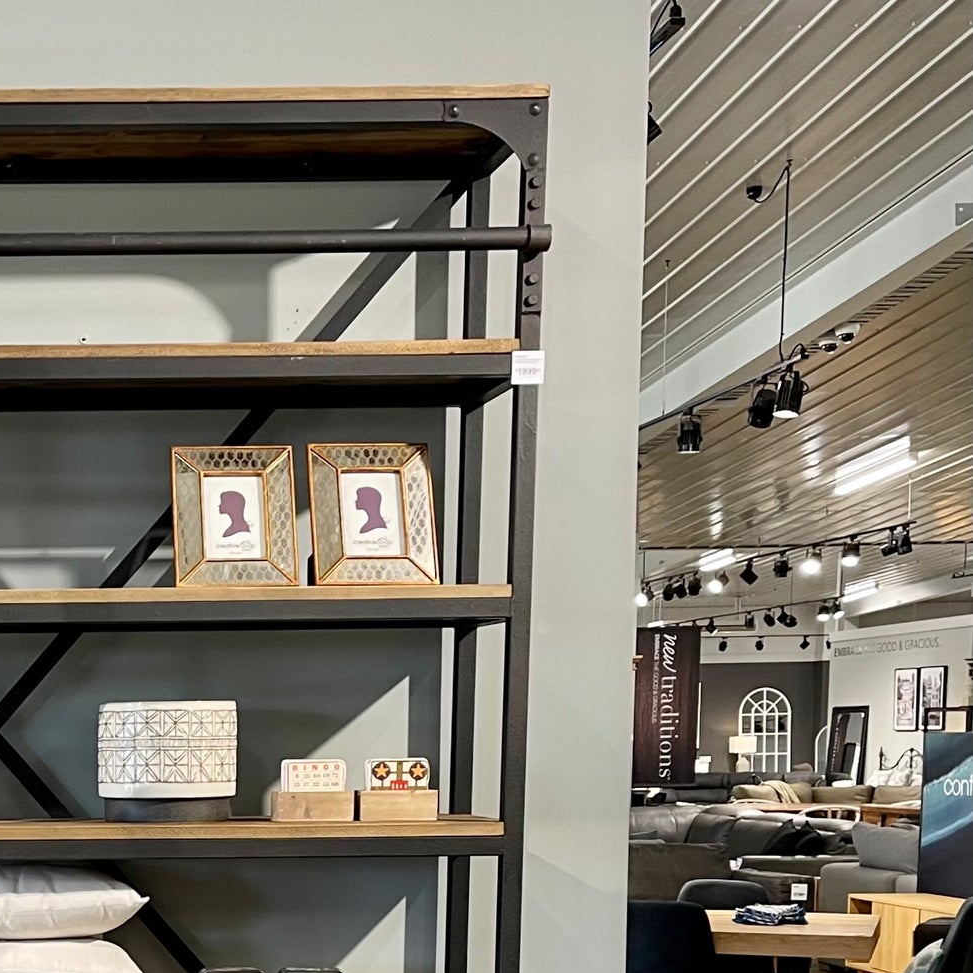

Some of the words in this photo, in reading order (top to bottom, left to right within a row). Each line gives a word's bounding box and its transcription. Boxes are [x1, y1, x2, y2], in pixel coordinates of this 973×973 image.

[663, 633, 677, 673] new
[877, 641, 897, 654] GOOD
[898, 640, 904, 651] &
[659, 676, 680, 778] traditions
